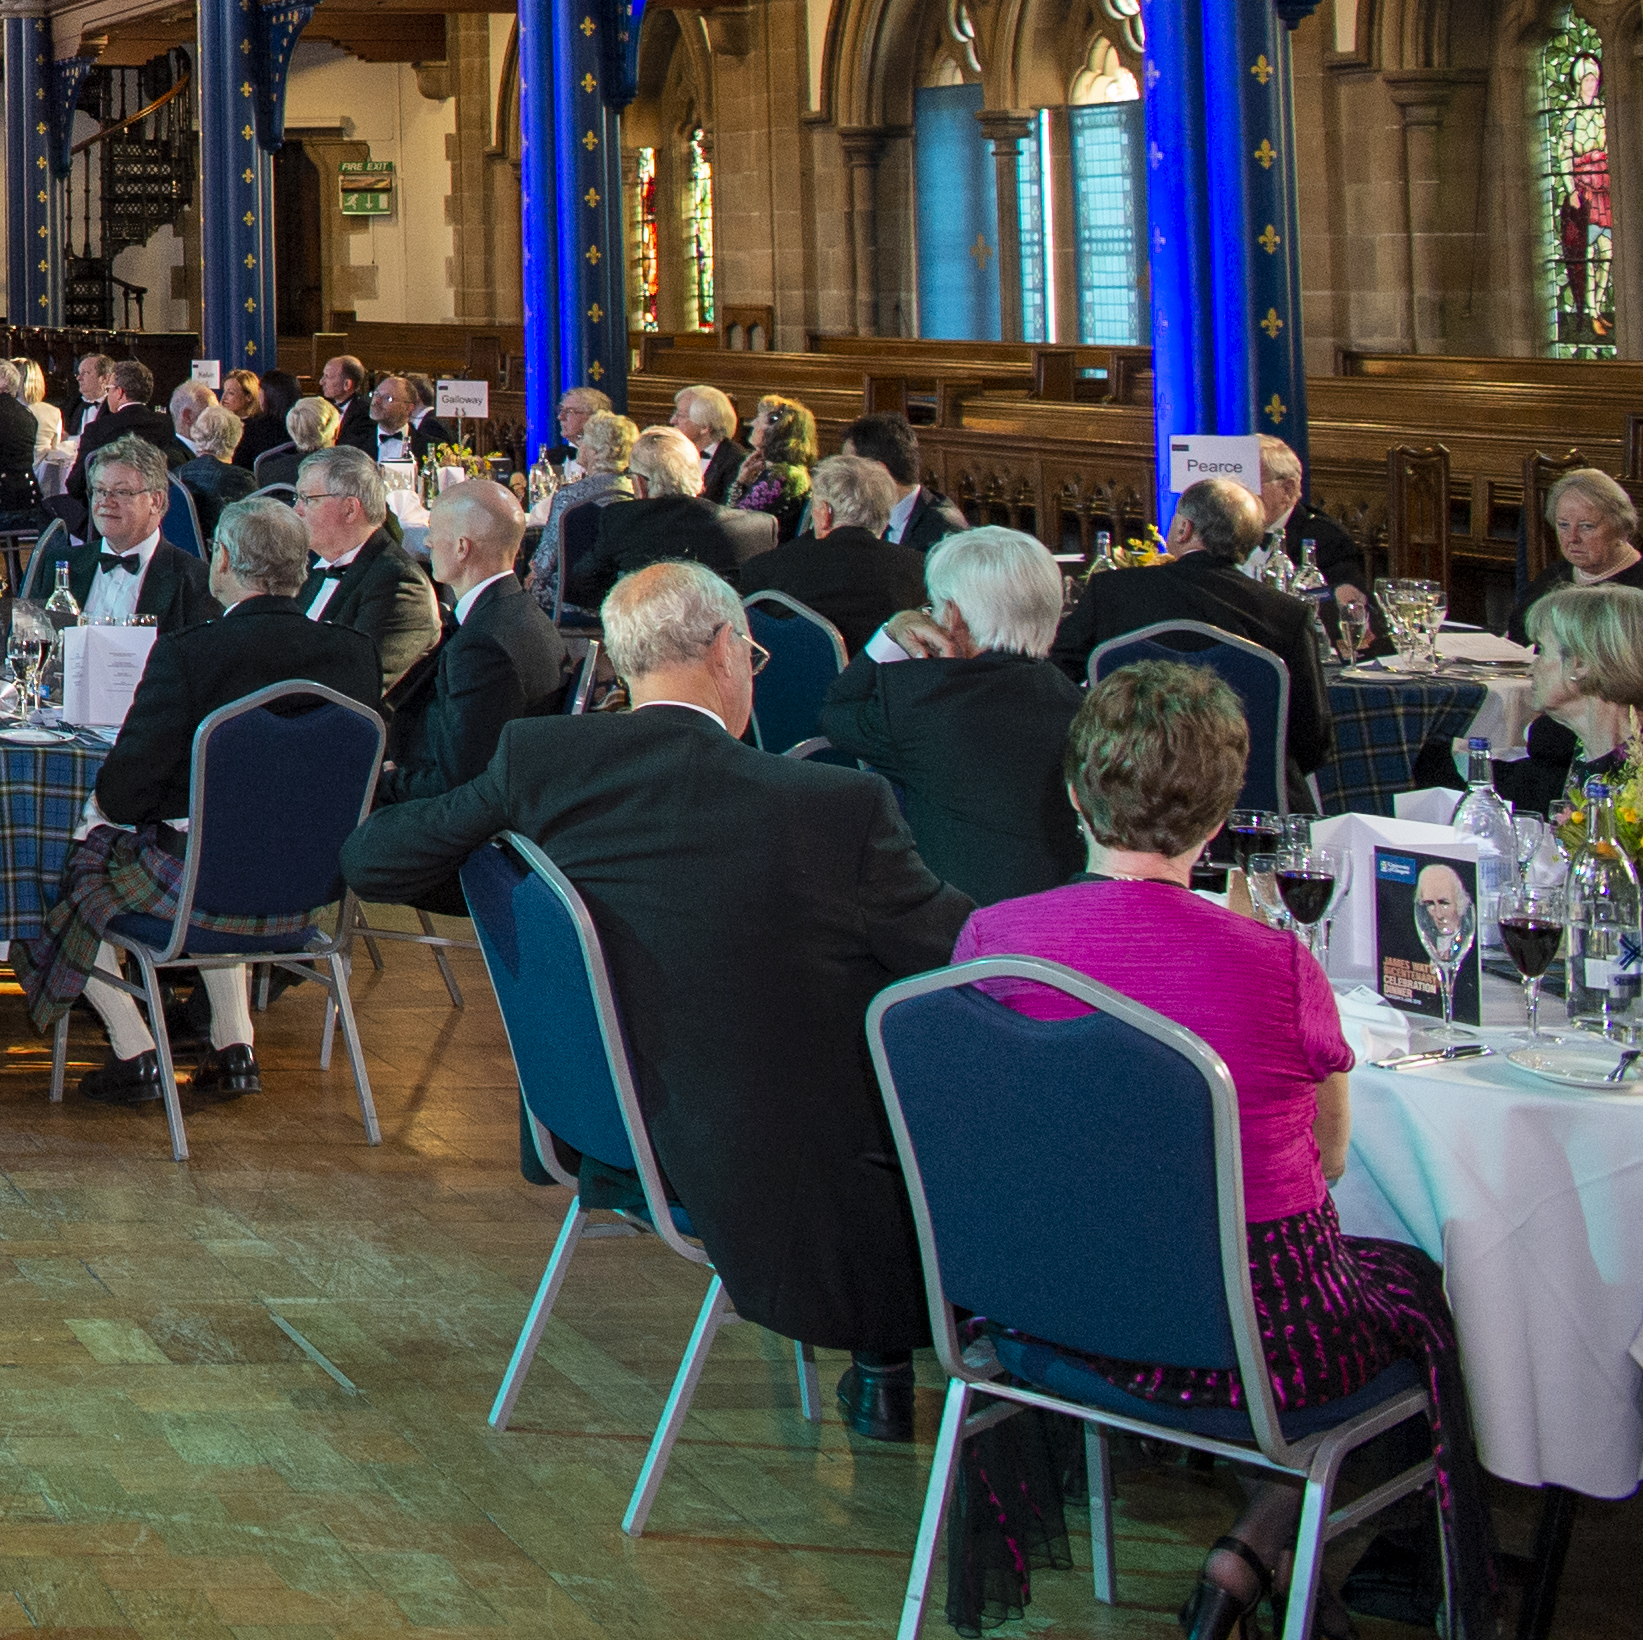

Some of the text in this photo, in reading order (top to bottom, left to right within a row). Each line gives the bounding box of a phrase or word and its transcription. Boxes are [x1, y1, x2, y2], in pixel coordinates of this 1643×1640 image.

[342, 162, 388, 171] FIRE EXIT
[441, 394, 484, 406] Galloway
[1186, 459, 1243, 473] Pearce
[1384, 975, 1437, 994] CELEBRATION
[1384, 984, 1413, 999] DINNER
